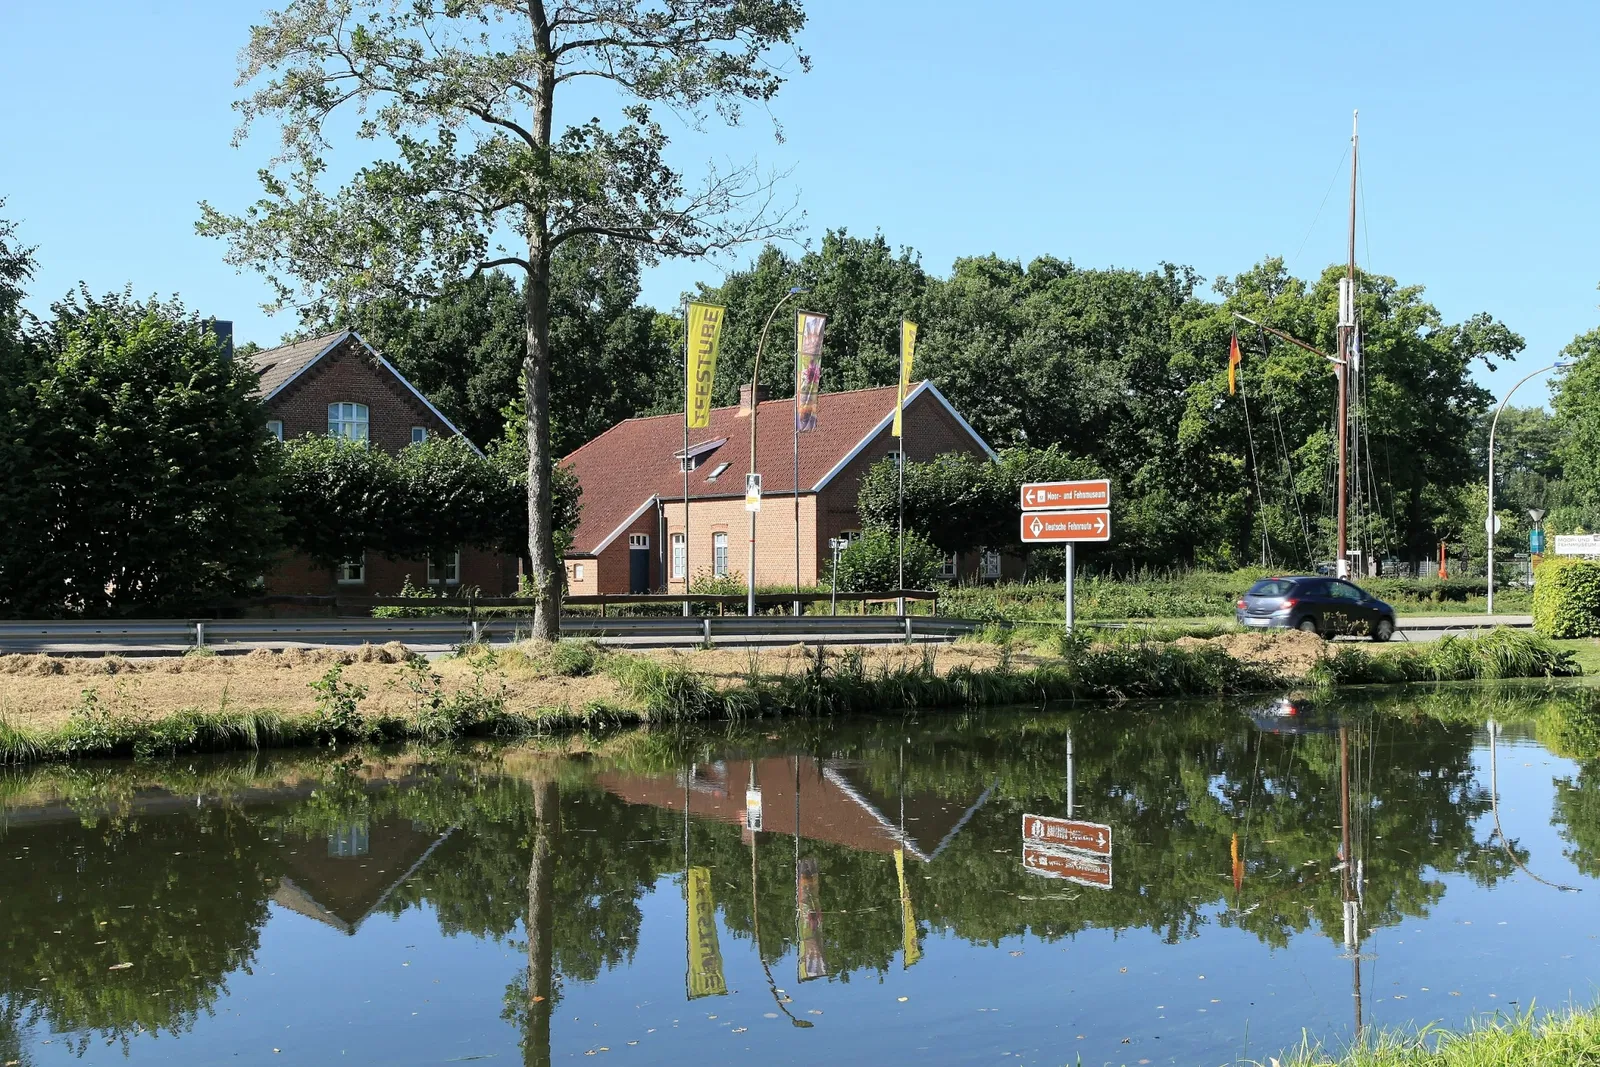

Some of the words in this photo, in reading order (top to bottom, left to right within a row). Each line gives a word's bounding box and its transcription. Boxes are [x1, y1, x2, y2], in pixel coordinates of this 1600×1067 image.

[695, 308, 719, 424] TEESTUBE
[1047, 491, 1062, 500] Moor-
[1064, 490, 1073, 499] und
[1073, 490, 1106, 499] Fehnmuseum
[1045, 522, 1066, 531] Deutsche
[1068, 522, 1091, 531] Fehnroute
